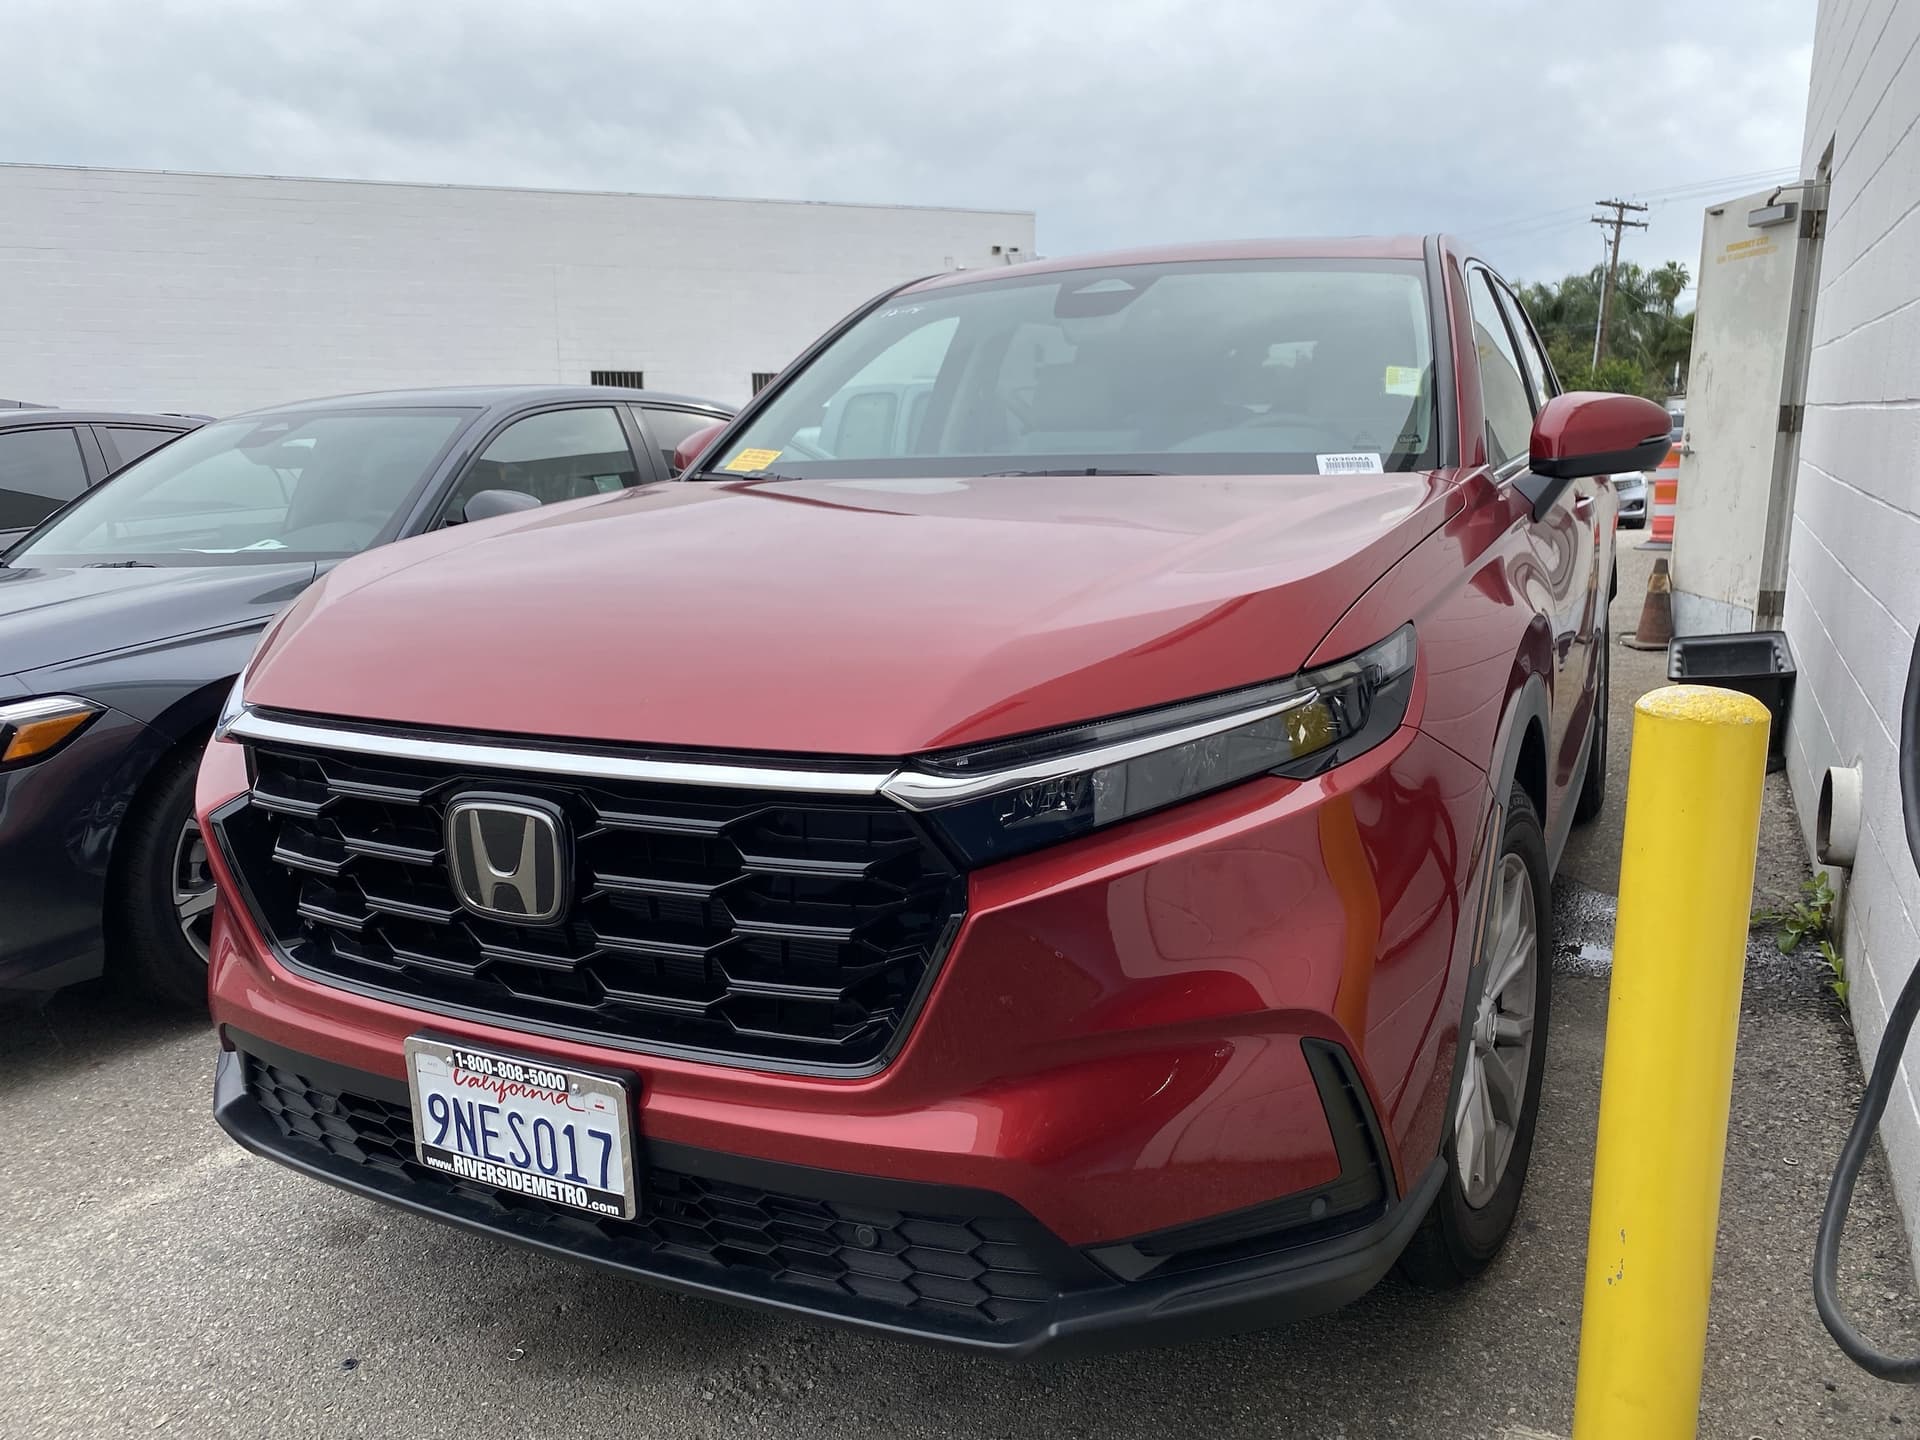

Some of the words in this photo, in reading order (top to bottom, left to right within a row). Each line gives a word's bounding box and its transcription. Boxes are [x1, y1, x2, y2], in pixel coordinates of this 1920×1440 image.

[455, 1052, 566, 1091] 1-800-808-5000
[428, 1093, 612, 1190] 9NES017
[426, 1155, 619, 1216] www.RIVERSIDEMETRO.com
